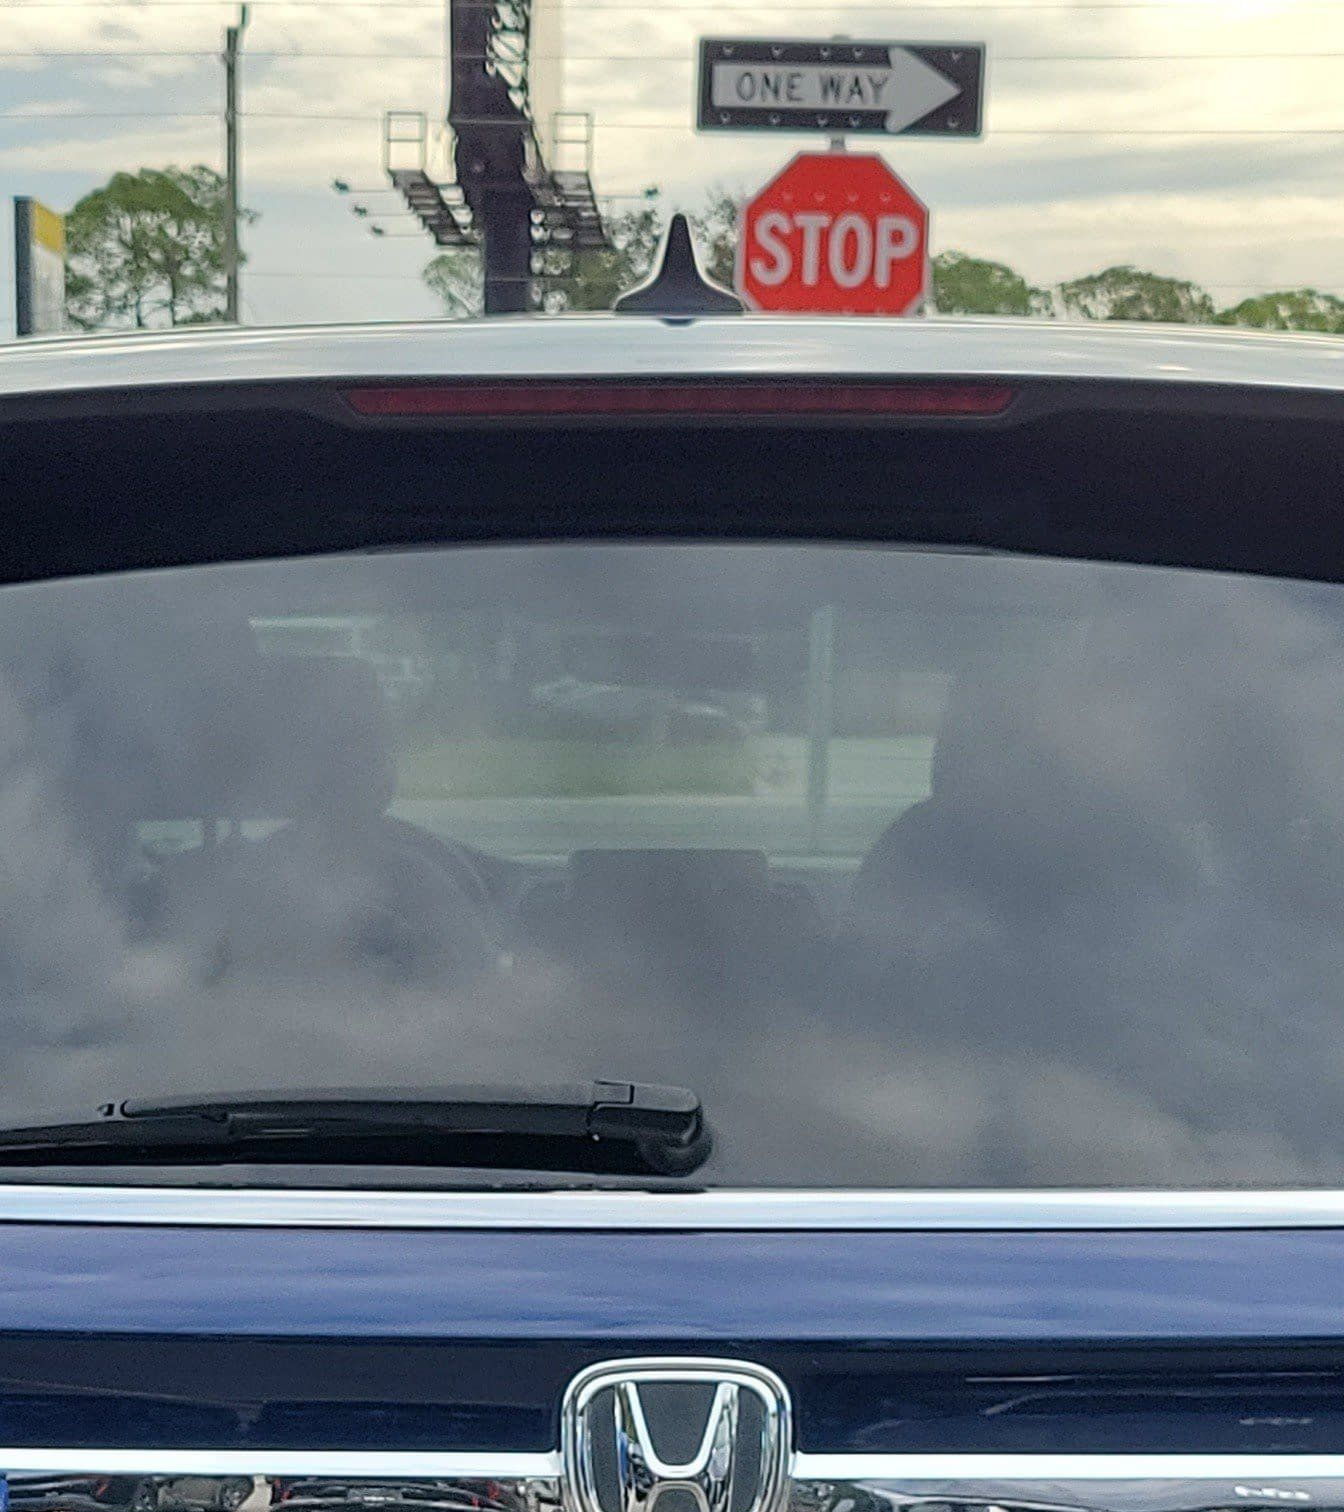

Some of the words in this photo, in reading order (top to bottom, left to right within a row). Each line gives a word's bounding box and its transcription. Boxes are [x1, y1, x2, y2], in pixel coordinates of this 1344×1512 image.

[735, 72, 805, 102] ONE
[820, 74, 889, 104] WAY
[750, 211, 919, 289] STOP
